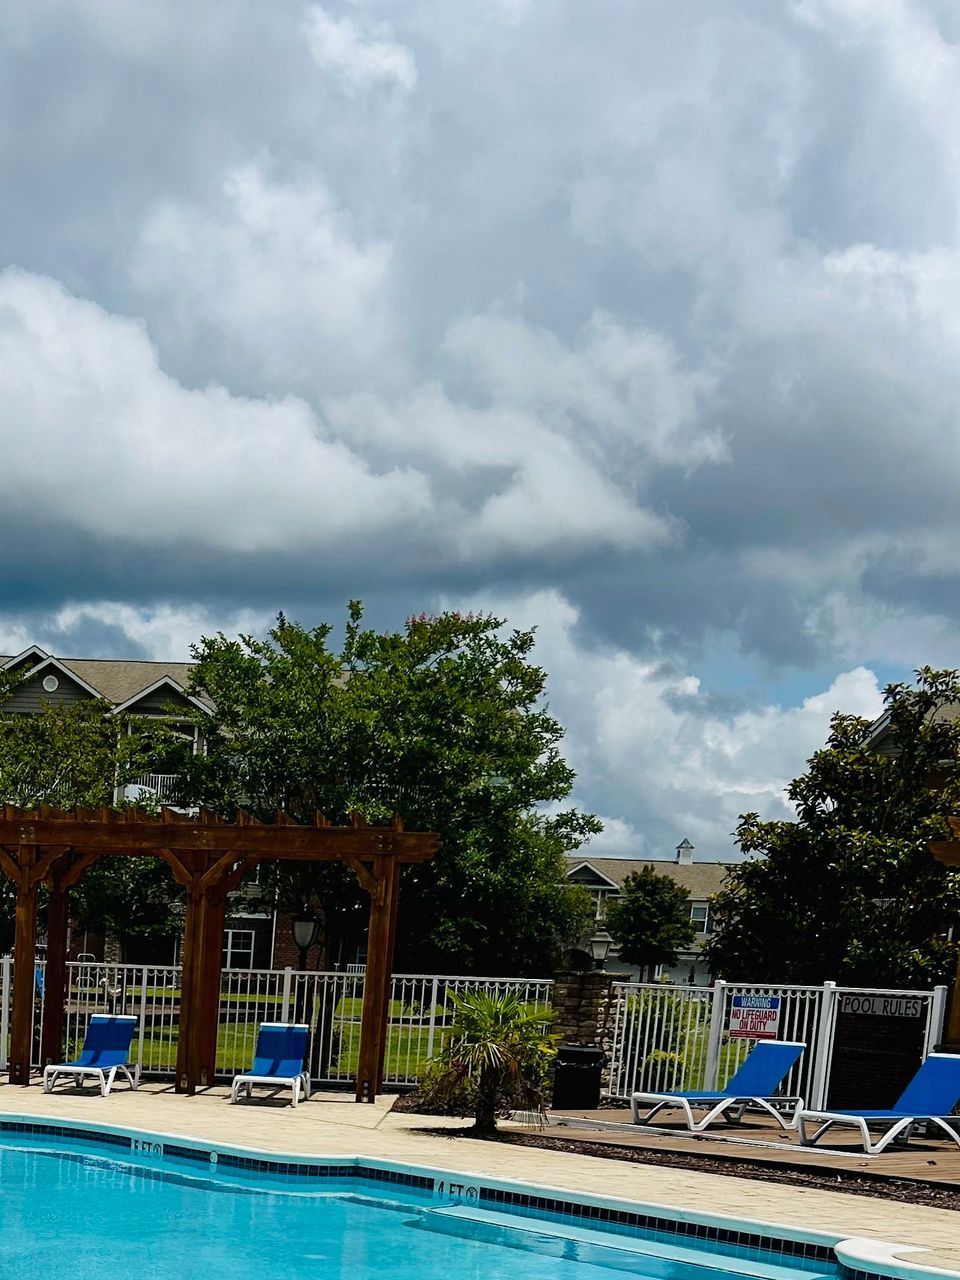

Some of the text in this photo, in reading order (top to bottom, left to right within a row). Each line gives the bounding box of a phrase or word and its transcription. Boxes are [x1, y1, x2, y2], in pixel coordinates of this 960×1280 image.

[741, 997, 771, 1008] WARNING
[844, 997, 918, 1016] POOL RULES
[732, 1009, 777, 1021] NO LIFEGUARD
[739, 1020, 767, 1030] ON DUTY
